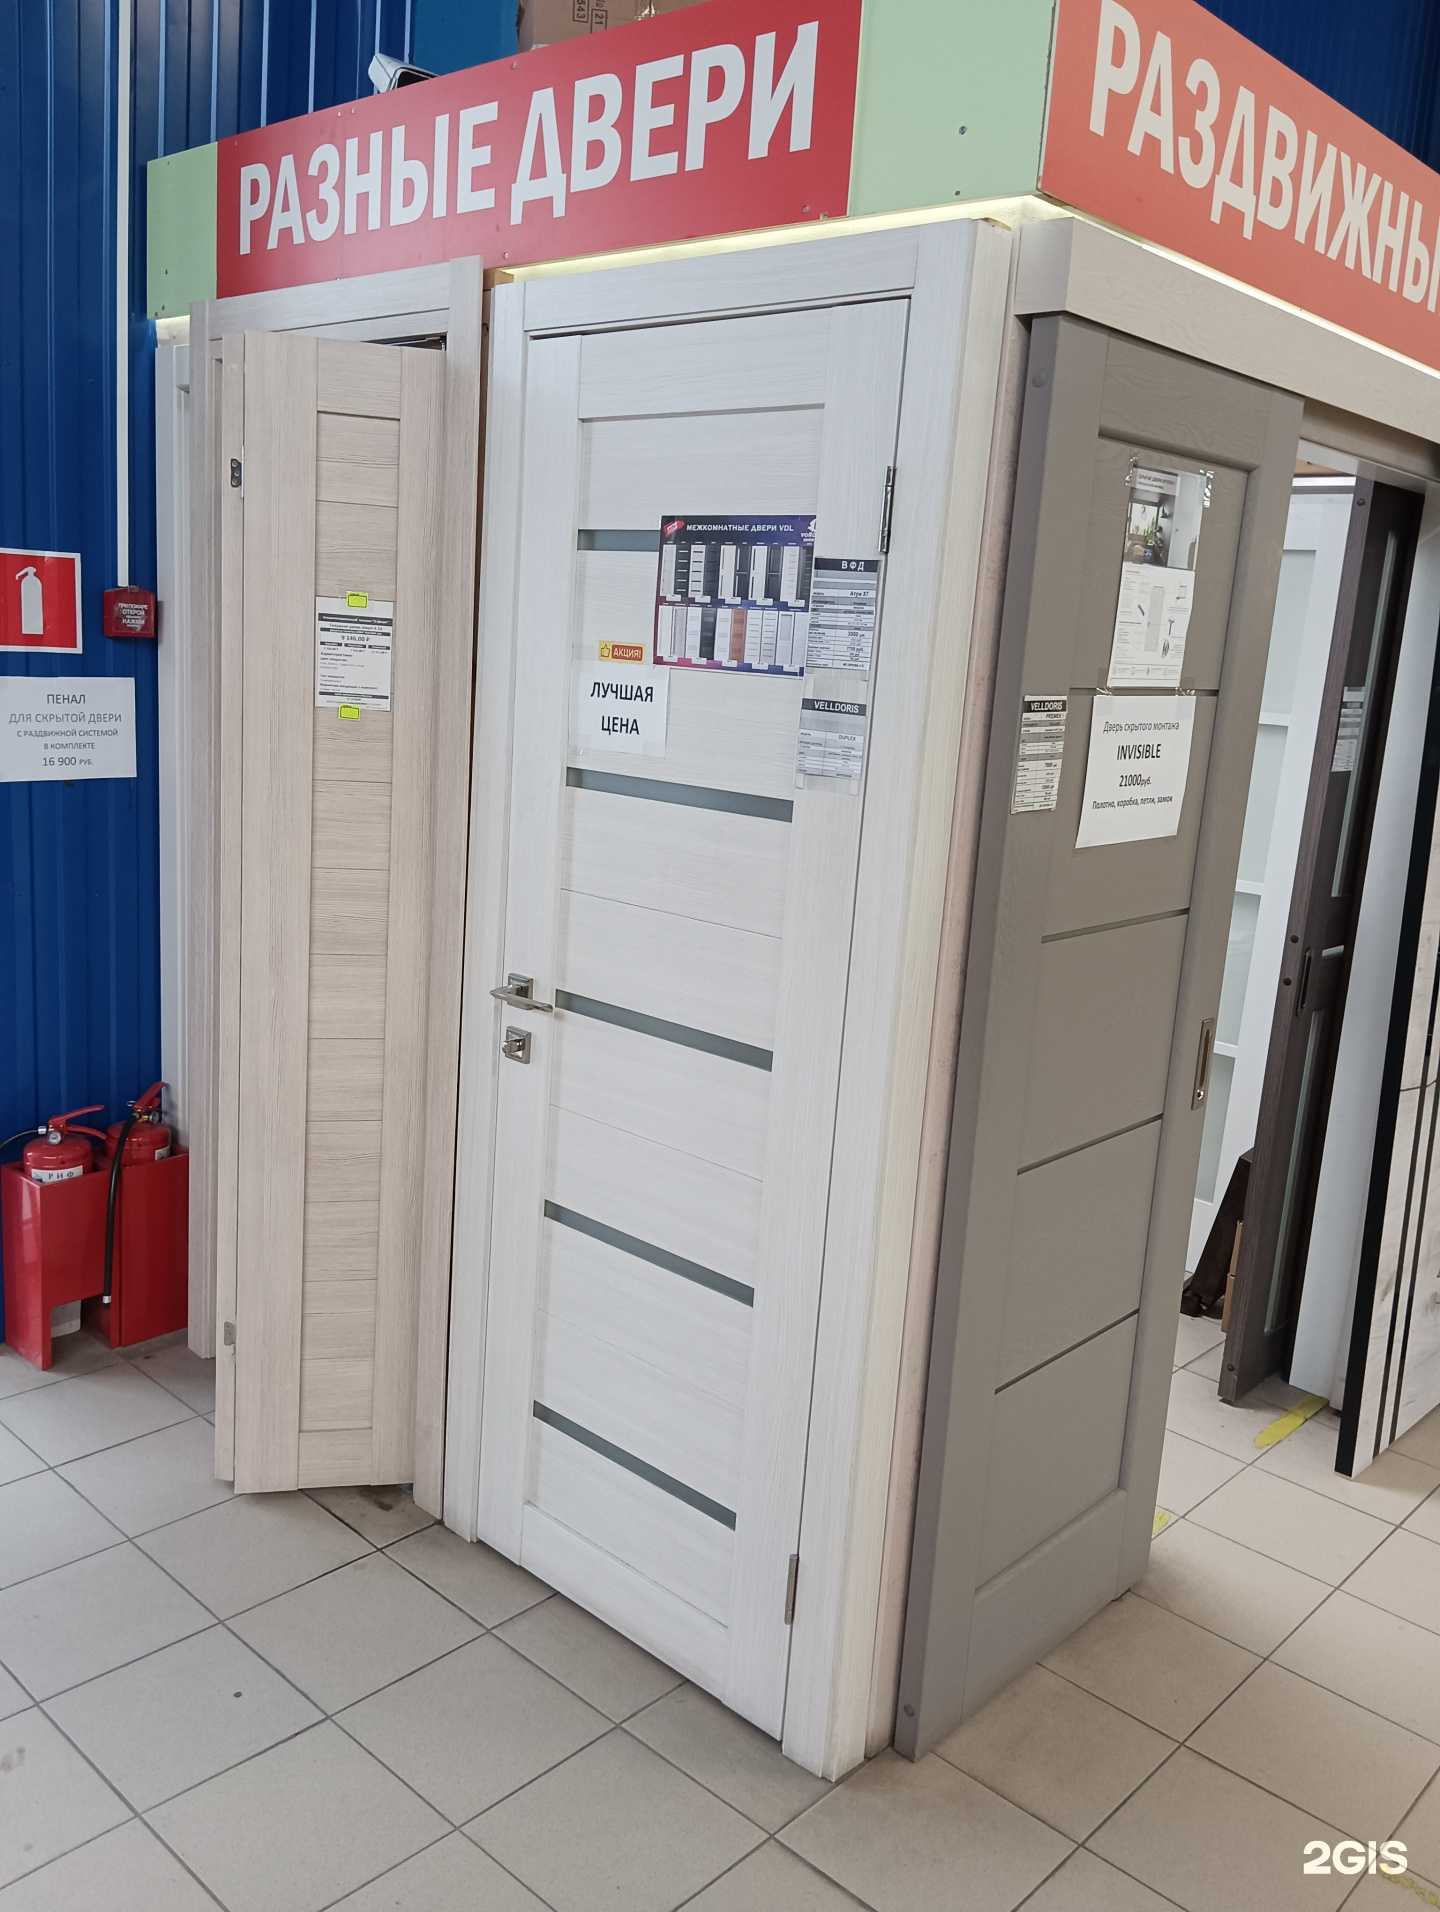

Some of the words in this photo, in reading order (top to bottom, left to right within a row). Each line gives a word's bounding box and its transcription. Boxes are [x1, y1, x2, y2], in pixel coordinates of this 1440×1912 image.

[239, 102, 497, 256] РАЗНЫЕ
[510, 21, 820, 225] ДВЕРИ
[1089, 0, 1440, 313] РАЗДВИЖНЫ
[686, 524, 750, 532] МЕЖКОМНАТНЫЕ
[751, 524, 777, 532] ДВЕРИ
[613, 647, 641, 659] АКЦИЯ!
[590, 681, 654, 703] ЛУЧШАЯ
[46, 693, 86, 704] ПЕНАЛ
[814, 701, 860, 713] VELLDORIS
[1030, 701, 1063, 711] VELLDORIS
[8, 713, 32, 724] ДЛЯ
[35, 711, 86, 723] СКРЫТОЙ
[88, 713, 122, 724] ДВЕРИ
[601, 715, 640, 736] ЦЕНА
[1103, 721, 1124, 734] Дверь
[1123, 722, 1152, 733] скрытого
[1153, 721, 1180, 731] монтажа
[24, 729, 77, 737] РАЗДВИЖНОЙ
[79, 728, 119, 737] СИСТЕМОЙ
[51, 742, 96, 750] КОМПЛЕКТЕ
[1117, 743, 1162, 761] INVISIBLE
[43, 757, 55, 766] 16
[57, 757, 77, 766] 900
